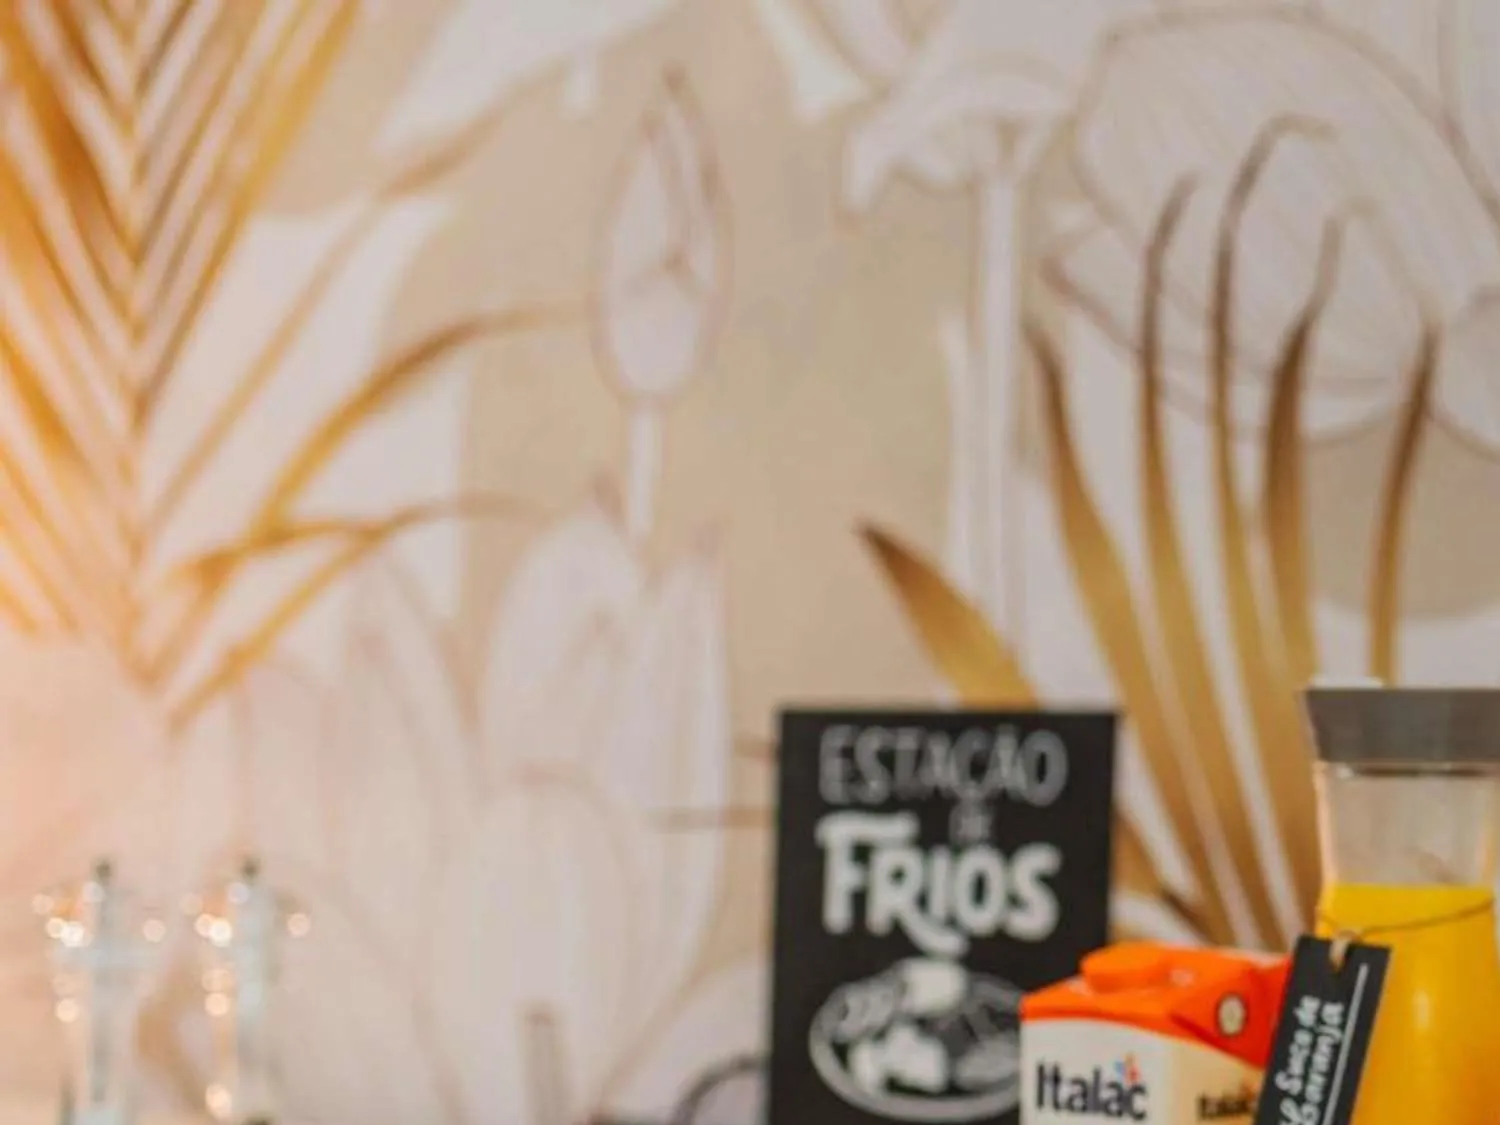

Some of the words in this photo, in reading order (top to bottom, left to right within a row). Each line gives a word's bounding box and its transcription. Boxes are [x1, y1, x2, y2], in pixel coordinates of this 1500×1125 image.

[818, 723, 1068, 806] ESTAÇÃO
[815, 809, 1062, 957] FRIOS
[1036, 1063, 1149, 1121] Italac
